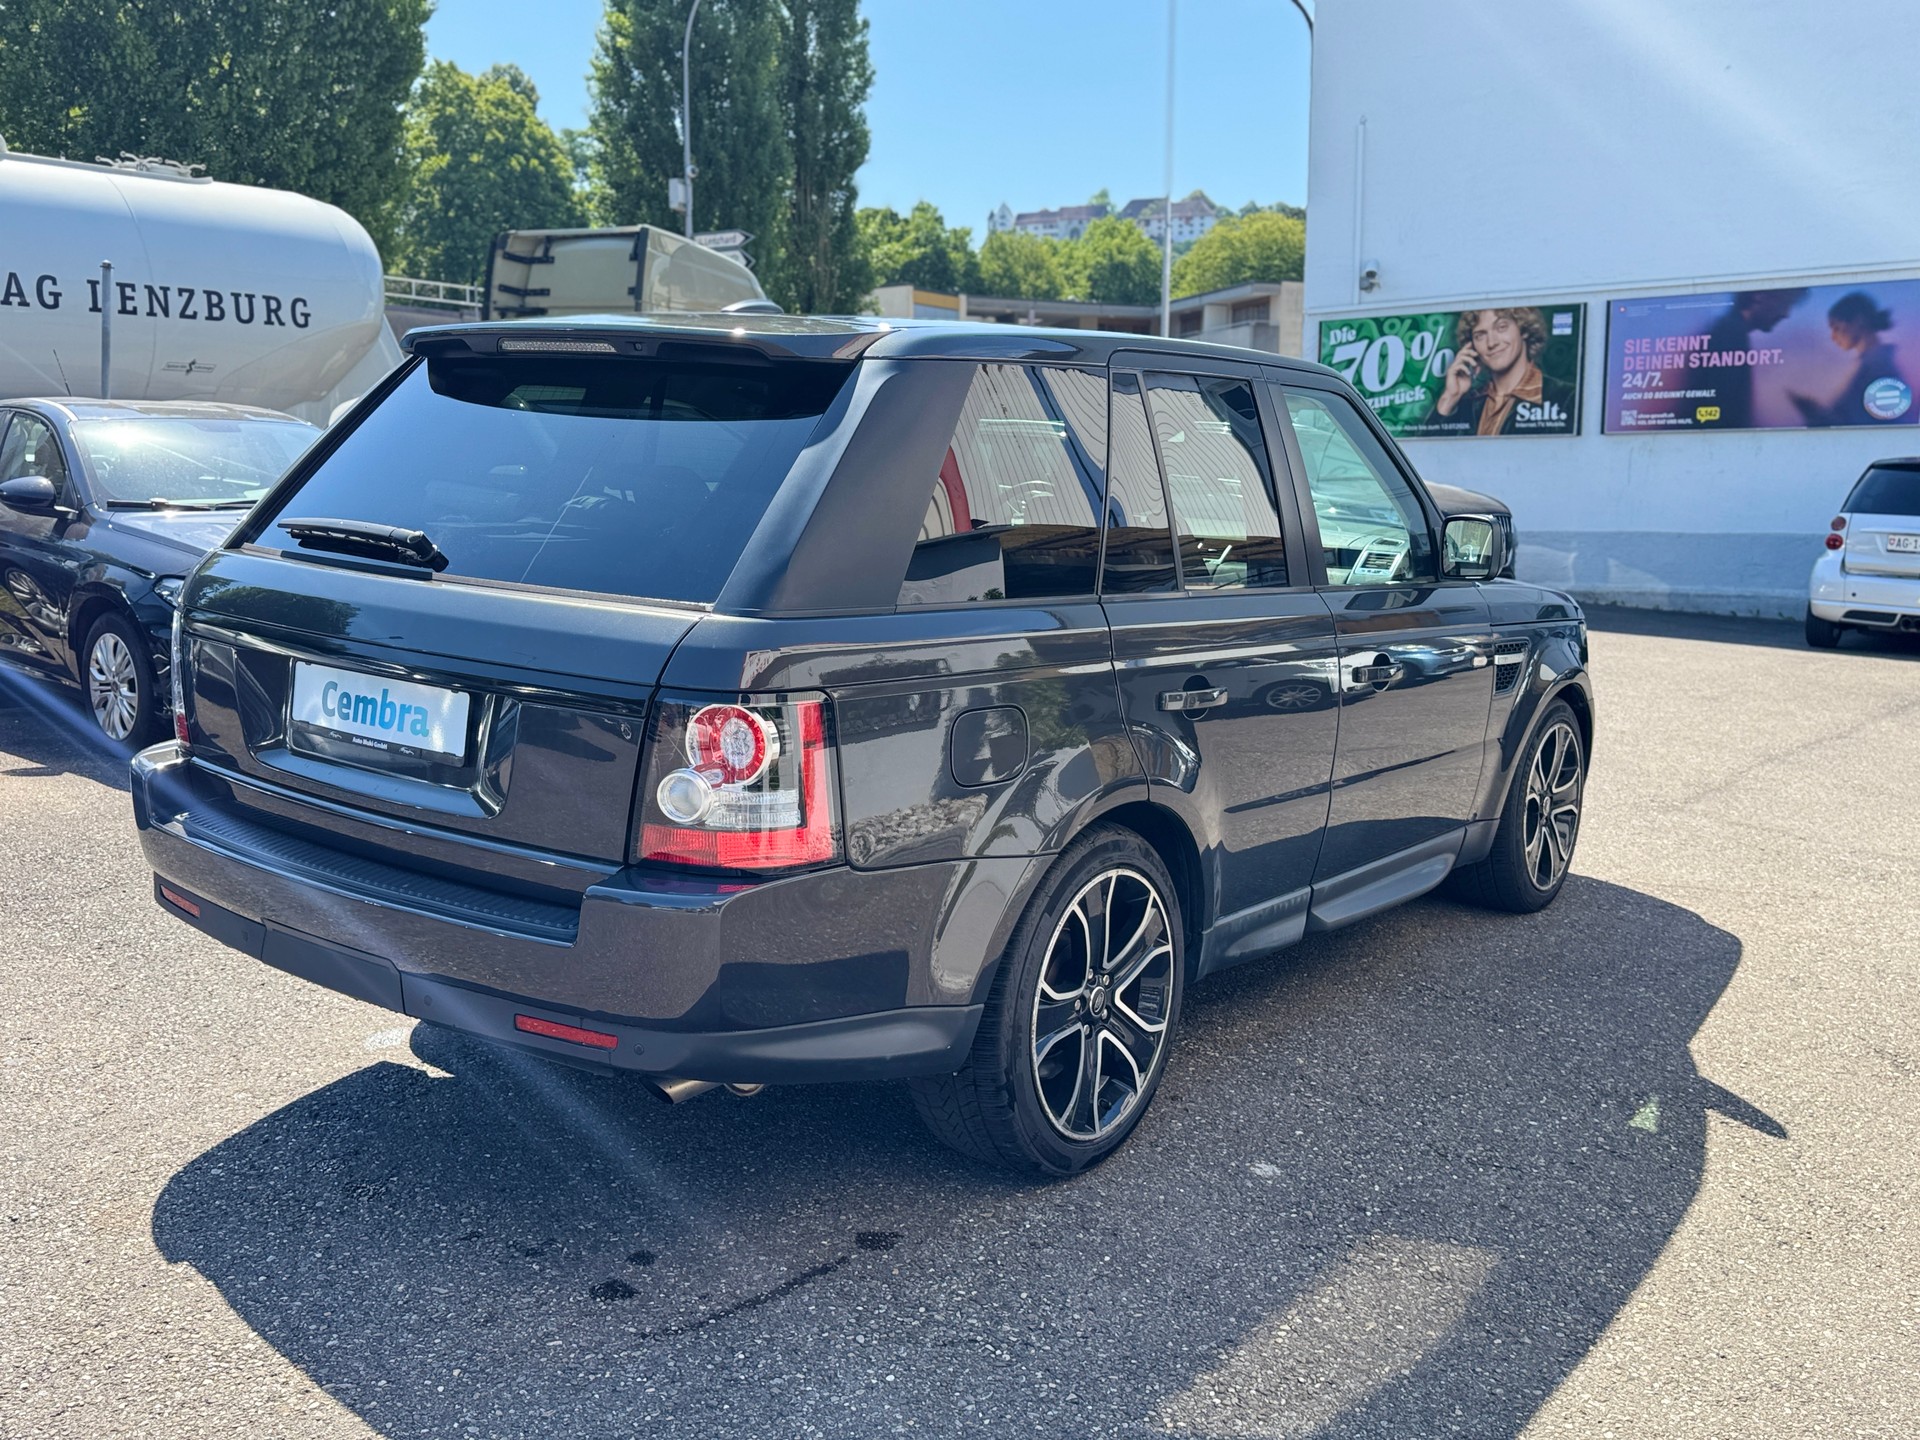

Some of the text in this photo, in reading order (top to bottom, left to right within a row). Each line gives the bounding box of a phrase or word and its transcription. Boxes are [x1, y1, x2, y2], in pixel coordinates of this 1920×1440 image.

[0, 271, 63, 310] AG
[1329, 328, 1357, 346] Die
[1624, 334, 1712, 354] SIE KENNT
[1331, 325, 1455, 393] 70%
[1623, 348, 1785, 371] DEINEN STANDORT.
[1621, 371, 1664, 389] 24/7.
[1365, 384, 1426, 411] zurück
[1621, 389, 1716, 400] AUCH SO BEGINNT GEWALT.
[1515, 400, 1568, 422] Salt.
[321, 680, 430, 738] Cembra
